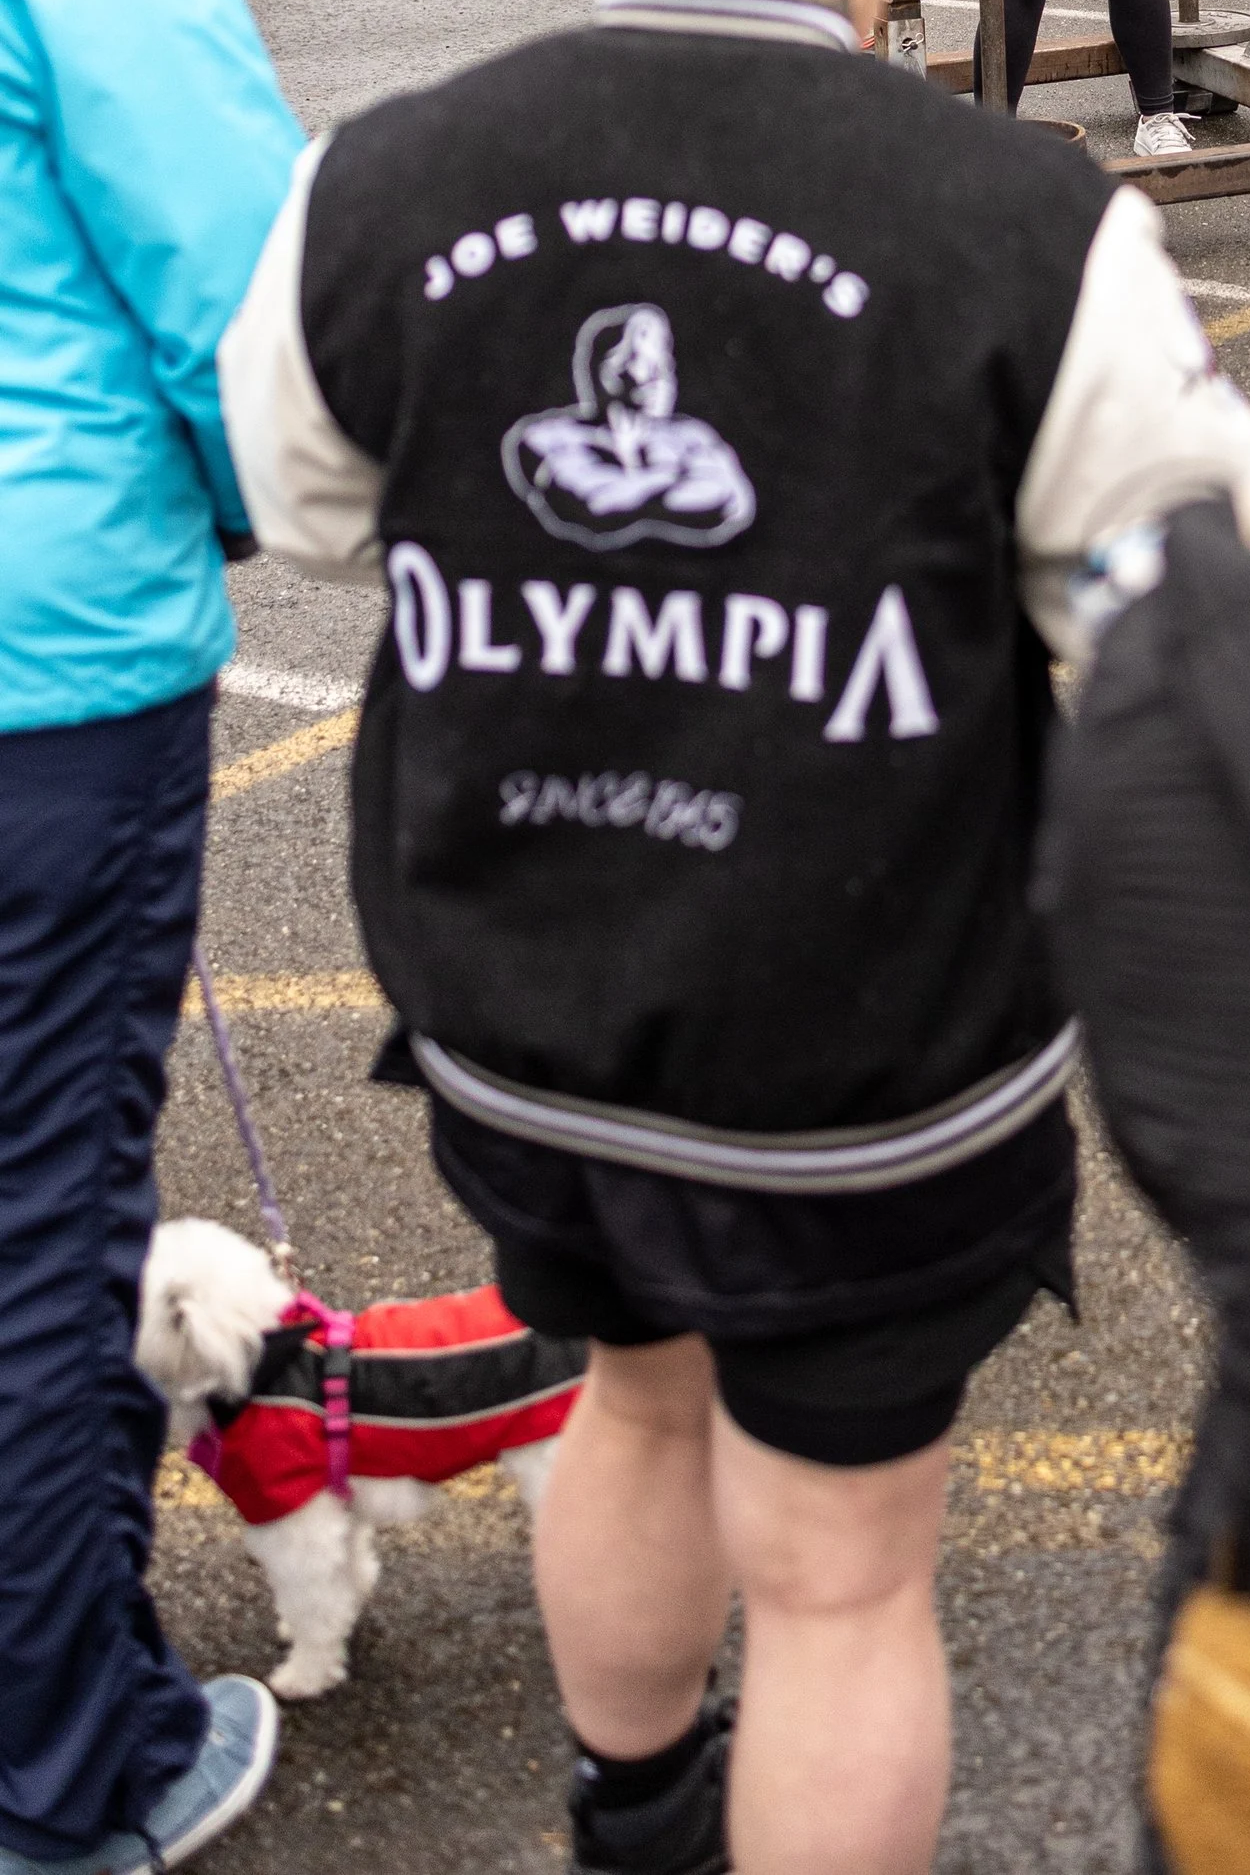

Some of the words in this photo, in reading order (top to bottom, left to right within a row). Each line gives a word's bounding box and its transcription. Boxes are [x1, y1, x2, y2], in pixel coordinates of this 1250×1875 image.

[424, 213, 538, 300] JOE
[560, 197, 870, 317] WEIDER'S
[387, 540, 939, 743] OLYMPIA
